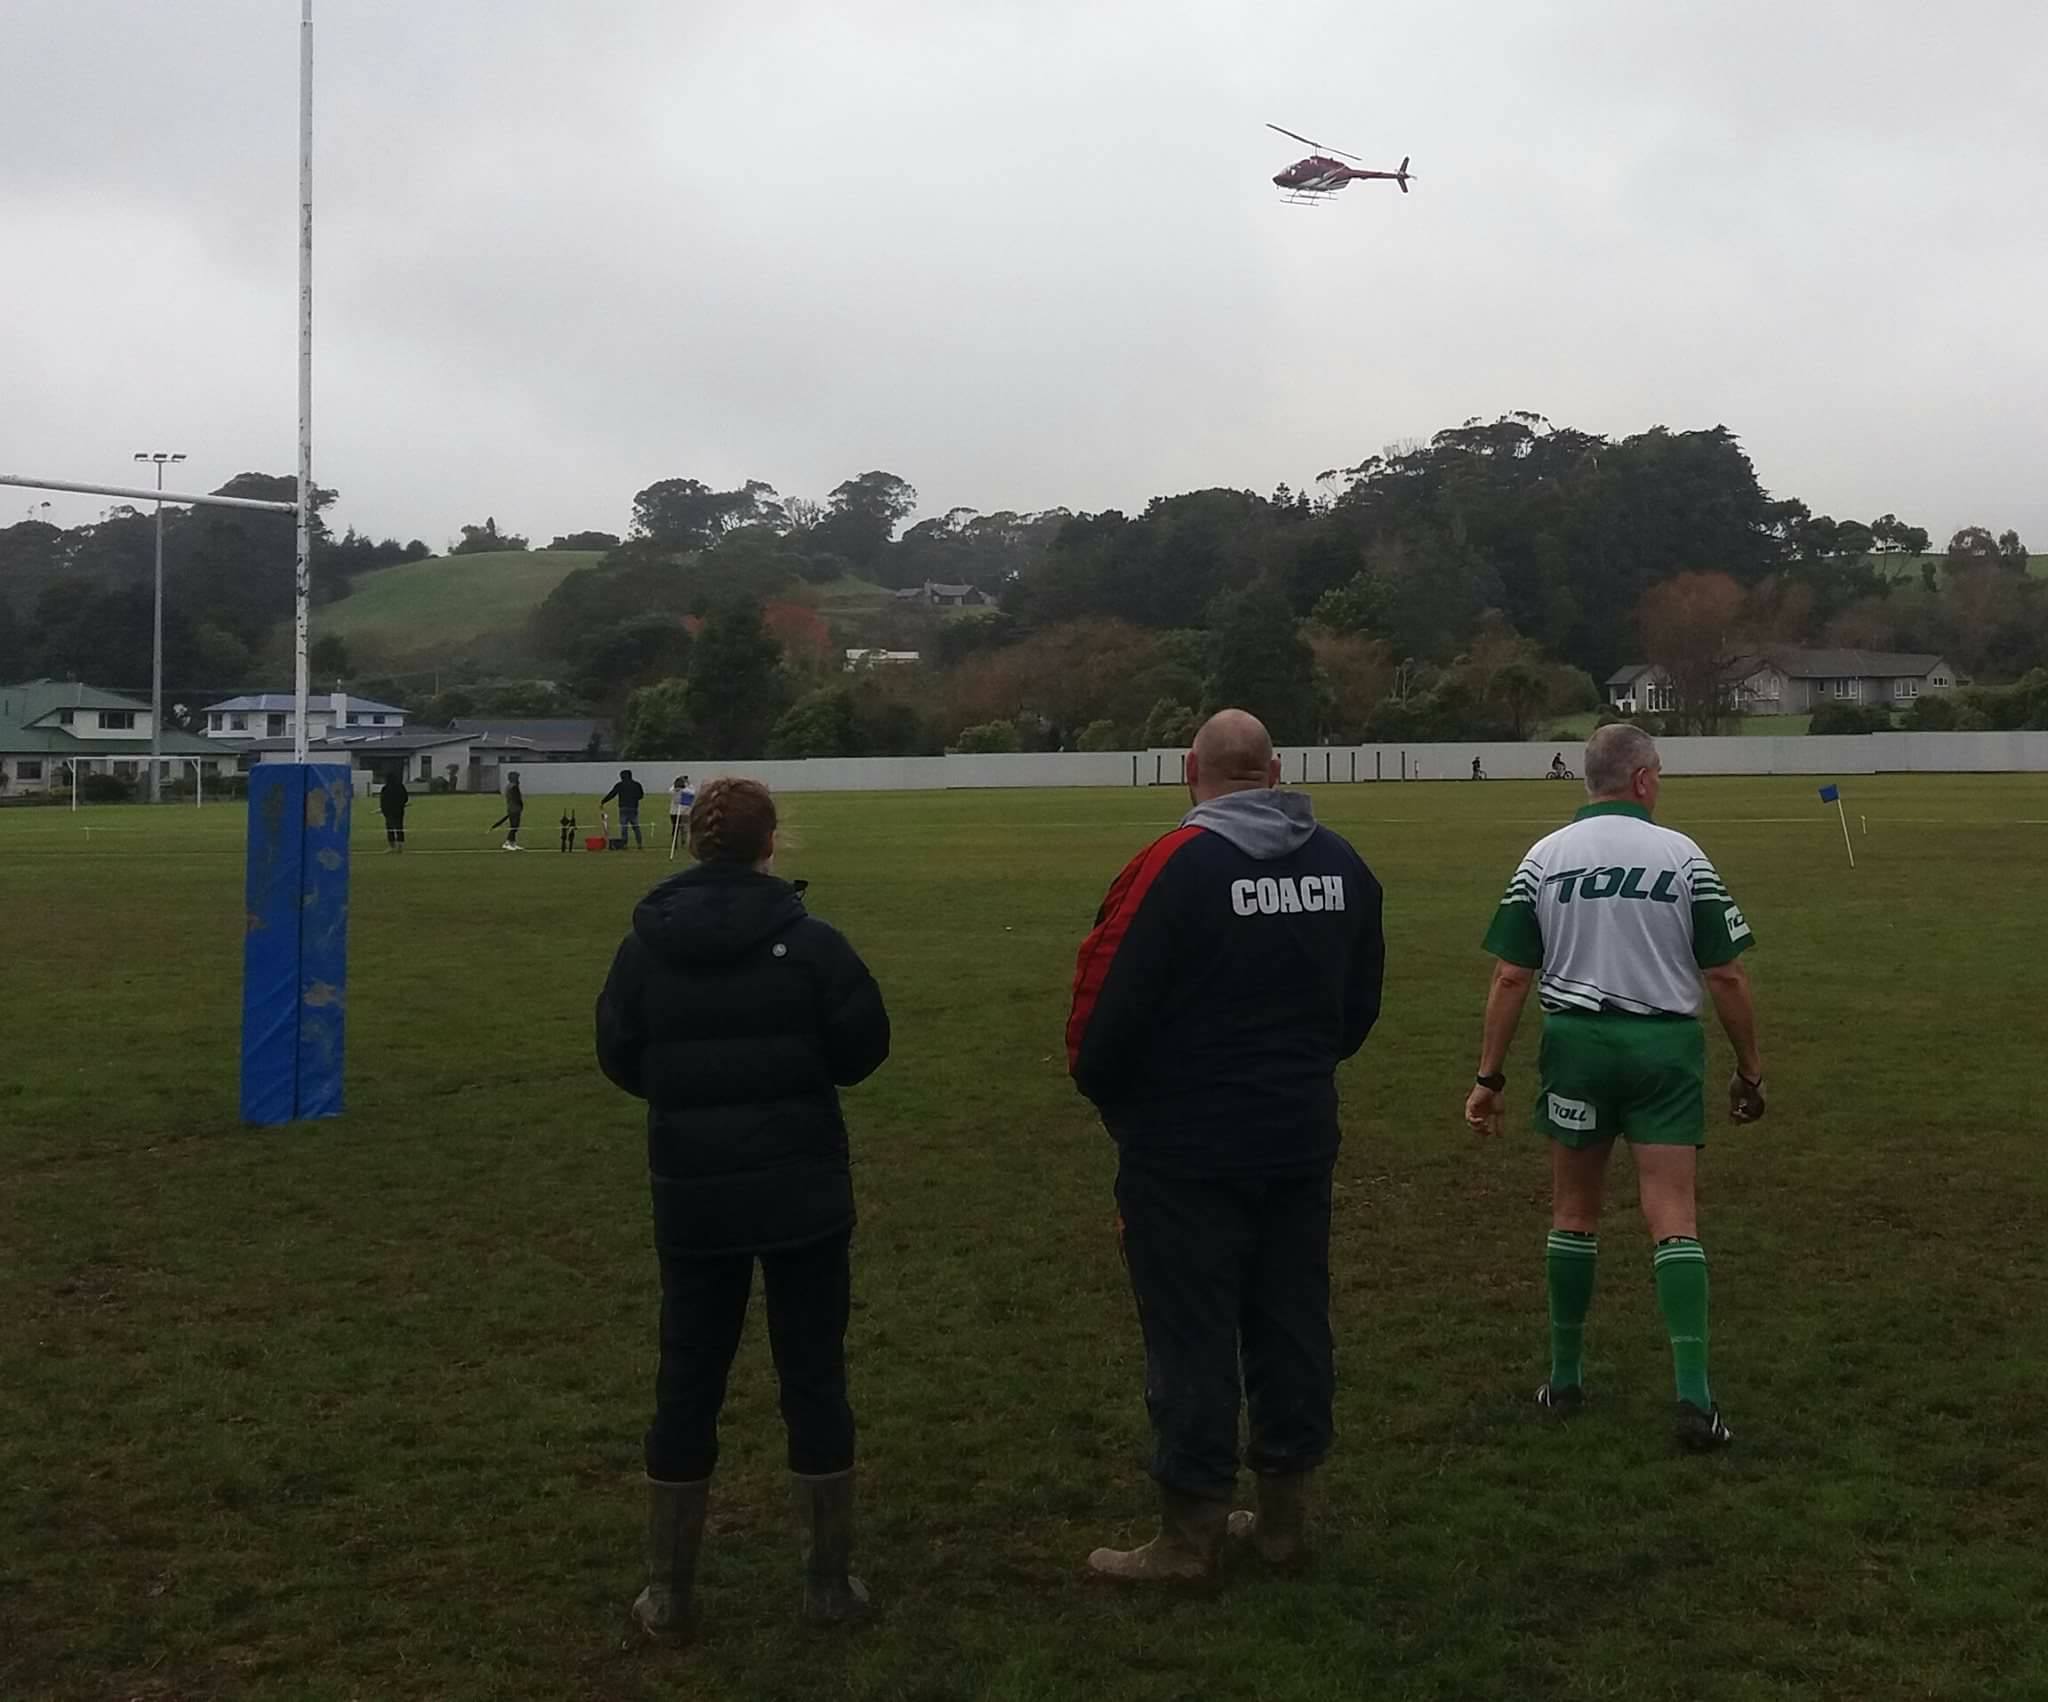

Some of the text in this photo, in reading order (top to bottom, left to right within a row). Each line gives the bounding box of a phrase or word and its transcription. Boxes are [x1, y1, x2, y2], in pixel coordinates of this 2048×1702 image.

[1231, 875, 1345, 916] COACH
[1544, 866, 1679, 904] TOLL
[1552, 1102, 1588, 1121] TOLL
